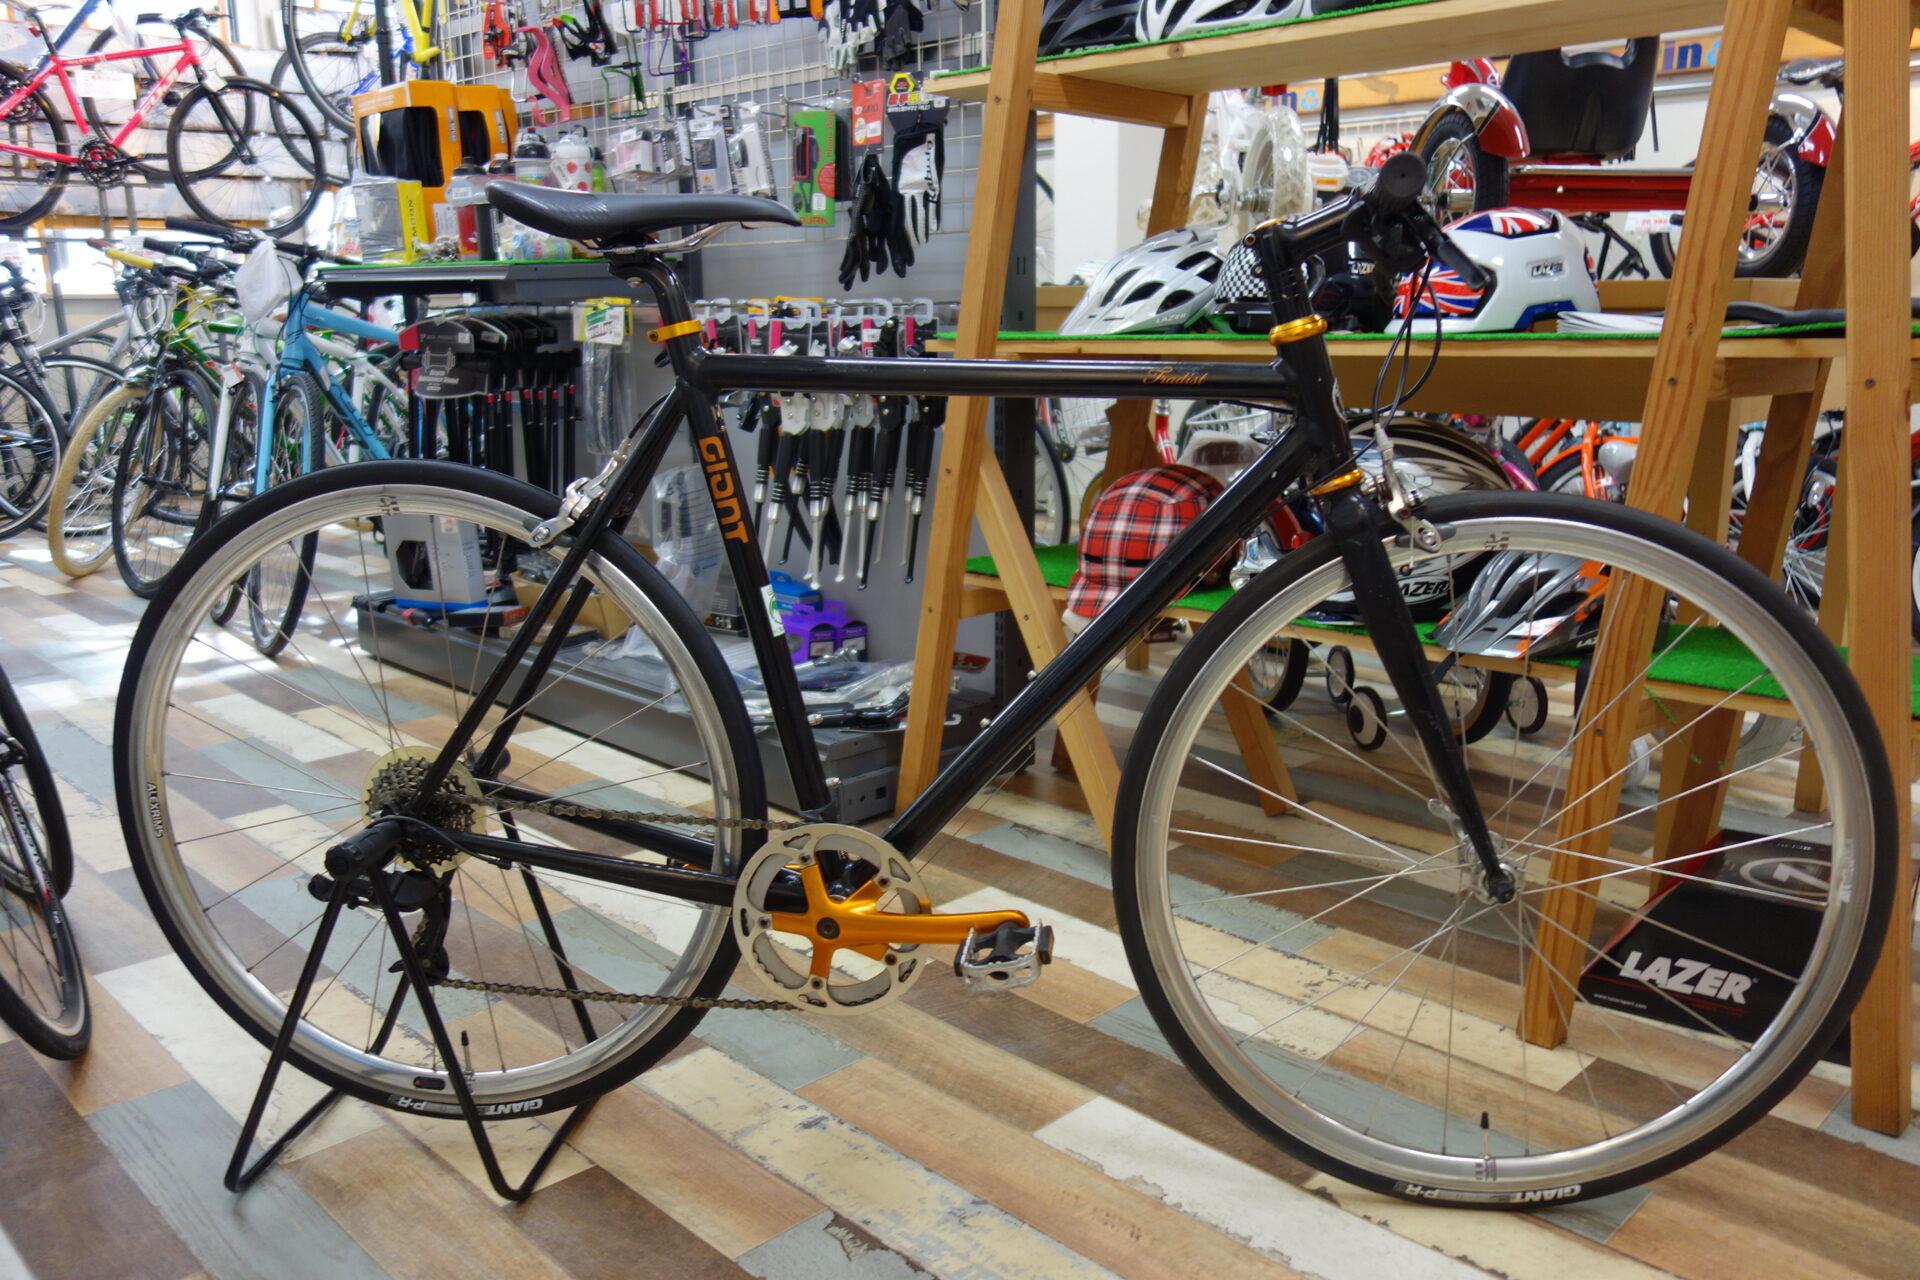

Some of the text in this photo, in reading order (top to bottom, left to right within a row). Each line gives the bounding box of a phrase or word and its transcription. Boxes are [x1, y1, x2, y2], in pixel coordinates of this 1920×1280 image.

[925, 139, 937, 204] Kabuto
[1155, 312, 1187, 324] LAZER
[1141, 366, 1208, 385] Tradist
[1400, 580, 1451, 597] AZER
[1619, 950, 1752, 1005] LAZER
[486, 1097, 543, 1115] GIANT
[1511, 1183, 1581, 1203] GIANT
